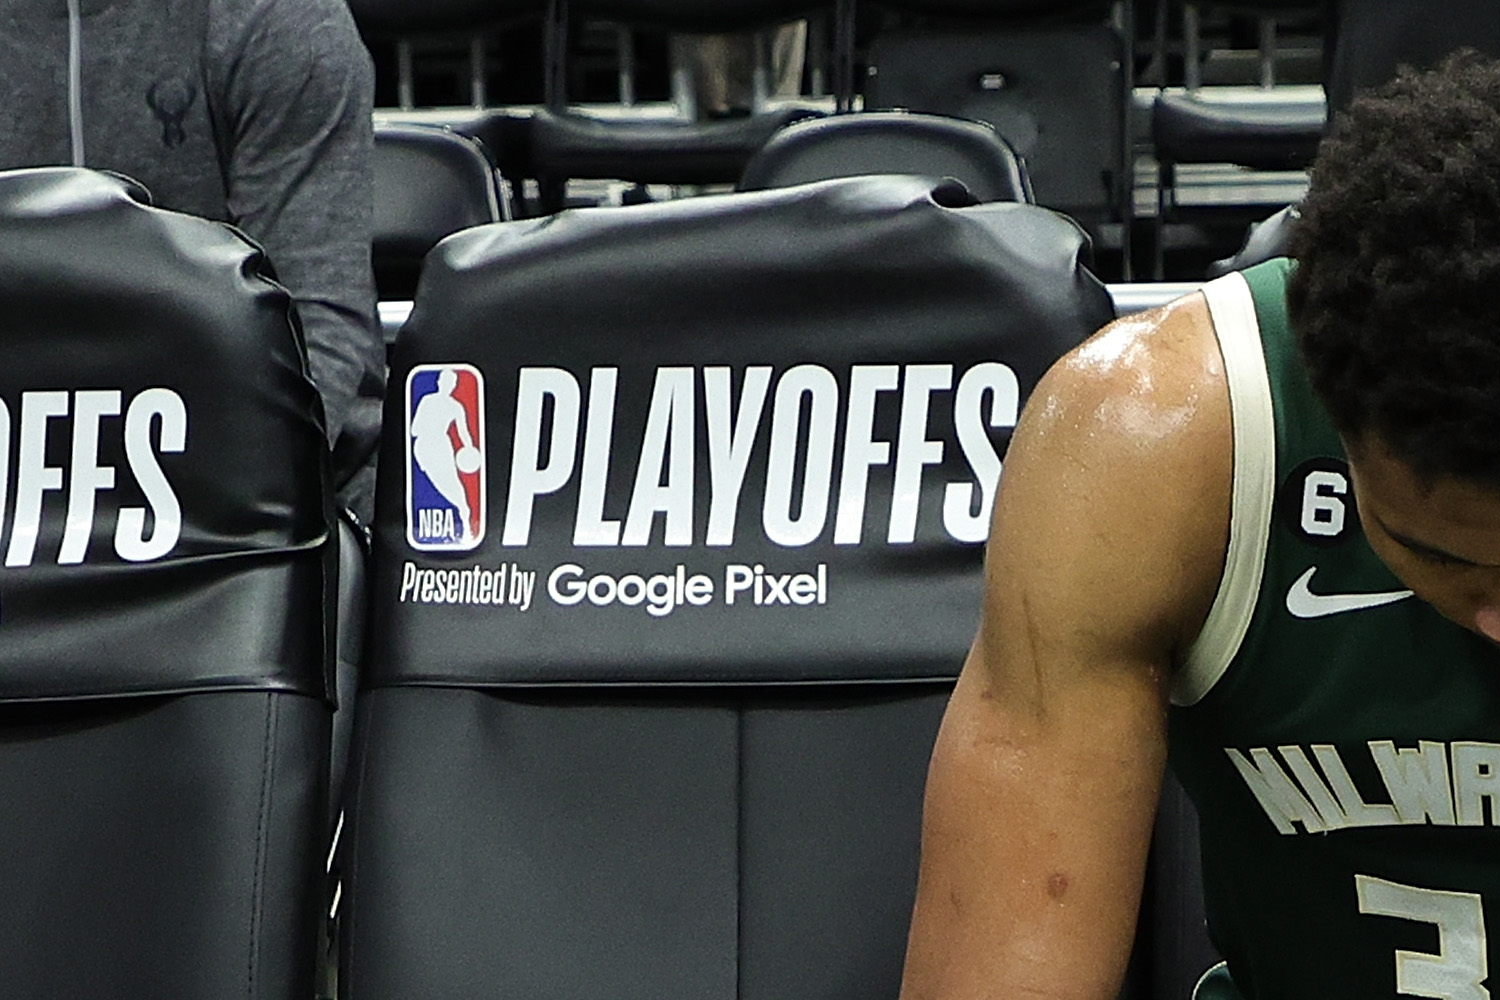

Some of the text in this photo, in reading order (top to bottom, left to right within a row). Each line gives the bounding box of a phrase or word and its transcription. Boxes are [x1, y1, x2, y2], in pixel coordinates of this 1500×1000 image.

[0, 387, 188, 567] FFS
[503, 363, 1019, 546] PLAYOFFS
[418, 508, 455, 540] NBA
[1300, 471, 1347, 536] 6
[400, 562, 827, 617] Presented by Google Pixel
